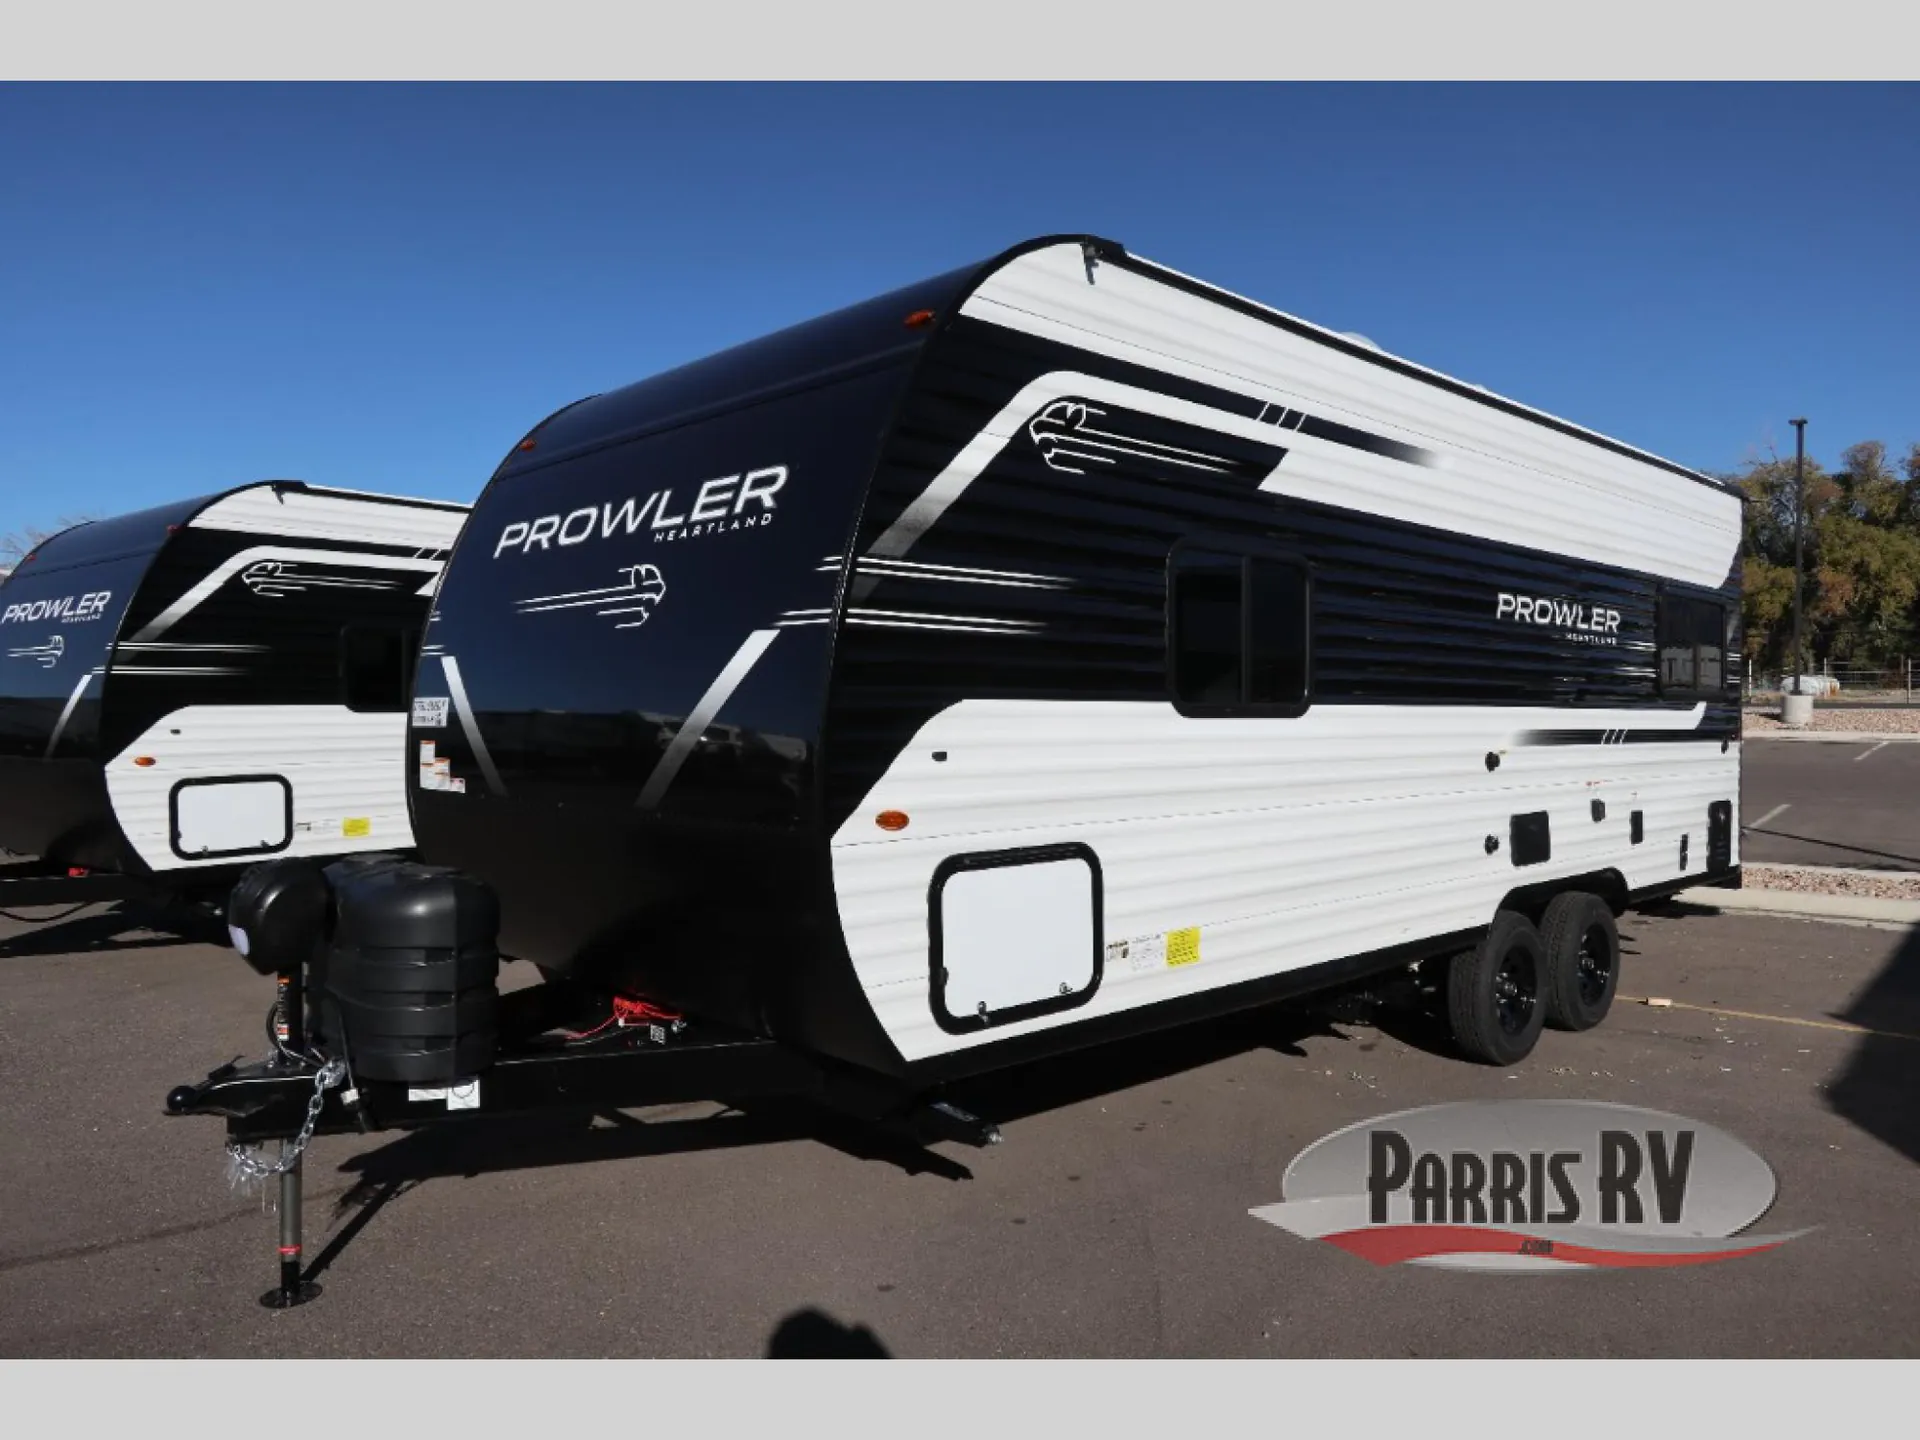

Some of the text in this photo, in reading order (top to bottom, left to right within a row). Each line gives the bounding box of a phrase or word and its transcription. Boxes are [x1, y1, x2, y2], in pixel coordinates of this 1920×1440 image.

[493, 465, 788, 558] PROWLER
[653, 513, 773, 543] HEARTLAND
[1, 591, 111, 625] PROWLER
[1496, 592, 1620, 633] PROWLER
